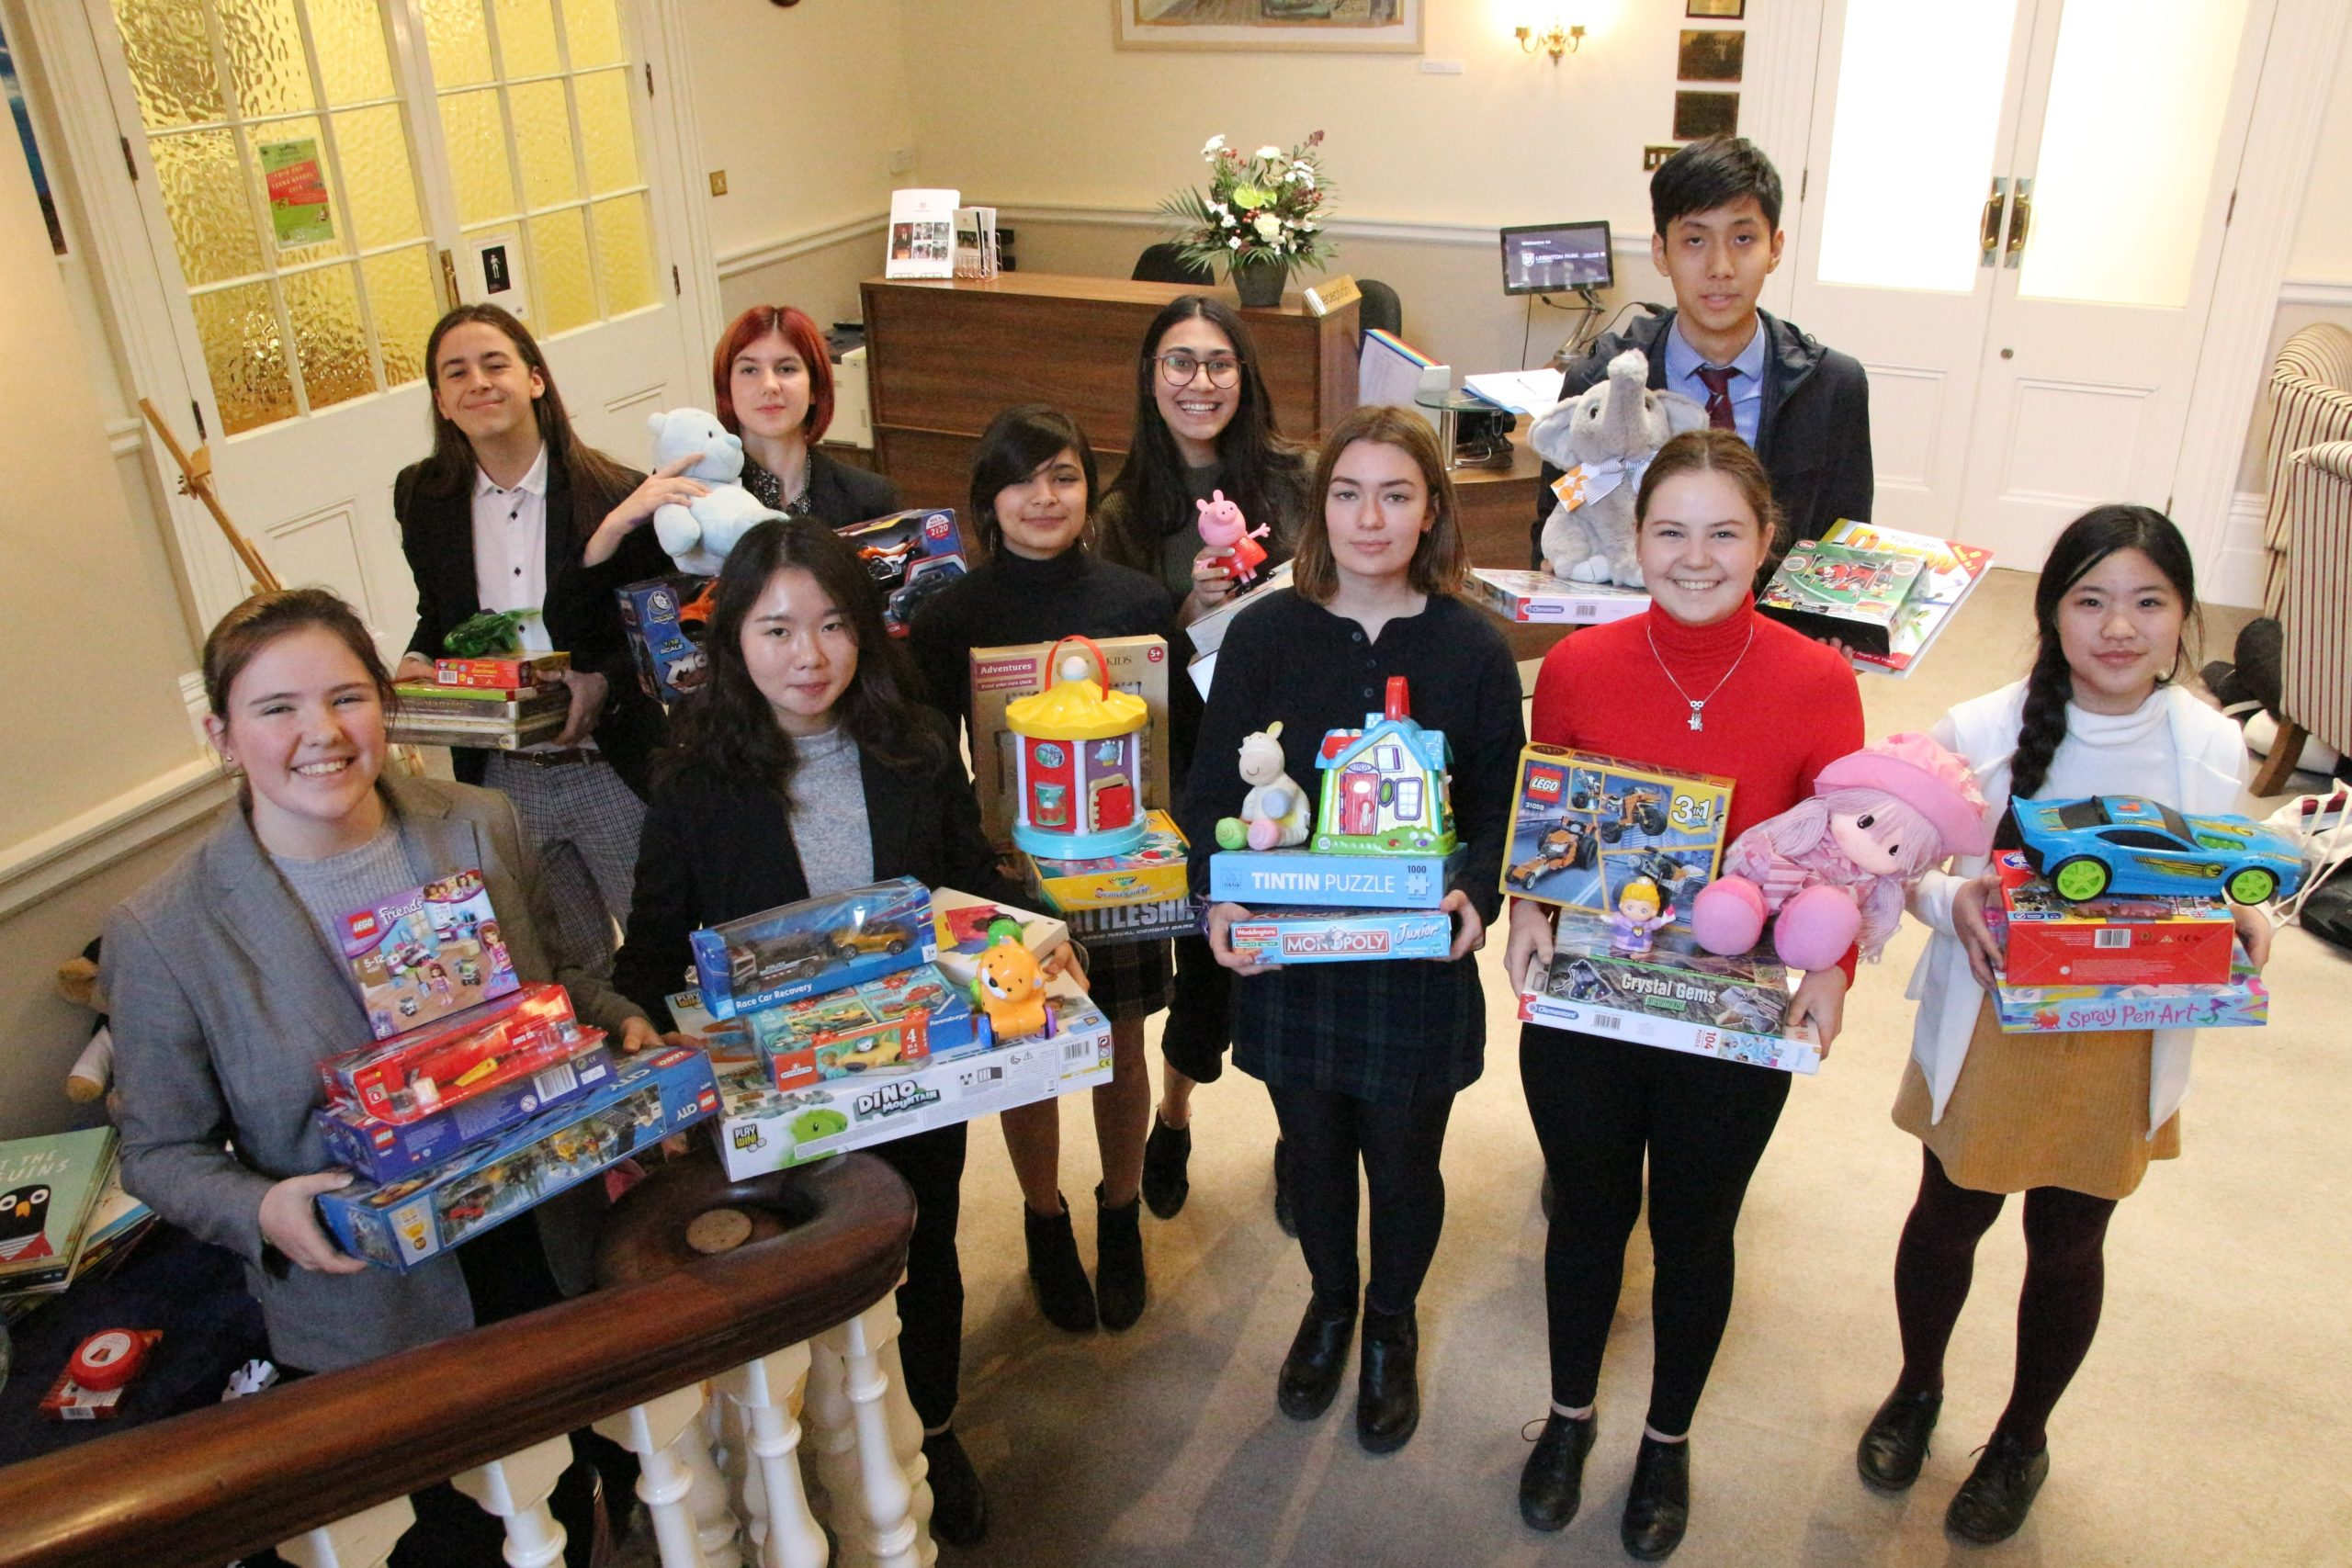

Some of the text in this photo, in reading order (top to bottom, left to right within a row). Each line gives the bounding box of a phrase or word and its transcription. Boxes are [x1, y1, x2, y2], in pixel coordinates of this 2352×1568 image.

[1890, 534, 1937, 549] You Can
[660, 644, 684, 654] SCALE
[1150, 649, 1162, 658] 5+
[980, 662, 1033, 675] Adventures
[1106, 656, 1133, 667] KIDS
[1529, 777, 1561, 793] LEGO
[1525, 802, 1545, 812] 31059
[1407, 864, 1428, 874] 1000
[1251, 872, 1396, 894] TINTIN PUZZLE
[379, 897, 424, 927] Friends
[353, 918, 375, 931] LEGO
[1108, 930, 1136, 939] NAVAL
[1136, 926, 1170, 935] COMBAT
[1395, 921, 1442, 944] Junior
[1237, 928, 1277, 938] Waddingtons
[1286, 934, 1385, 953] MONOPOLY
[926, 947, 936, 958] 3+
[363, 953, 386, 969] 5-12
[735, 982, 813, 1010] Race Car Recovery
[1622, 973, 1673, 998] Crystal
[1675, 982, 1717, 1005] Gems
[929, 1011, 968, 1026] Ravensburger
[1538, 1005, 1576, 1020] Clementoni
[2067, 1003, 2200, 1028] Spray Pen Art
[906, 1028, 917, 1043] 4
[1704, 1031, 1717, 1051] 104
[658, 1050, 688, 1066] LEGO
[609, 1068, 651, 1091] CITY
[700, 1094, 716, 1108] LEGO
[858, 1080, 917, 1115] DINO
[882, 1089, 939, 1114] MOUNTAIN
[676, 1102, 697, 1122] CITY
[734, 1124, 757, 1140] PLAY
[735, 1134, 758, 1148] WIN!
[22, 1149, 58, 1166] THE
